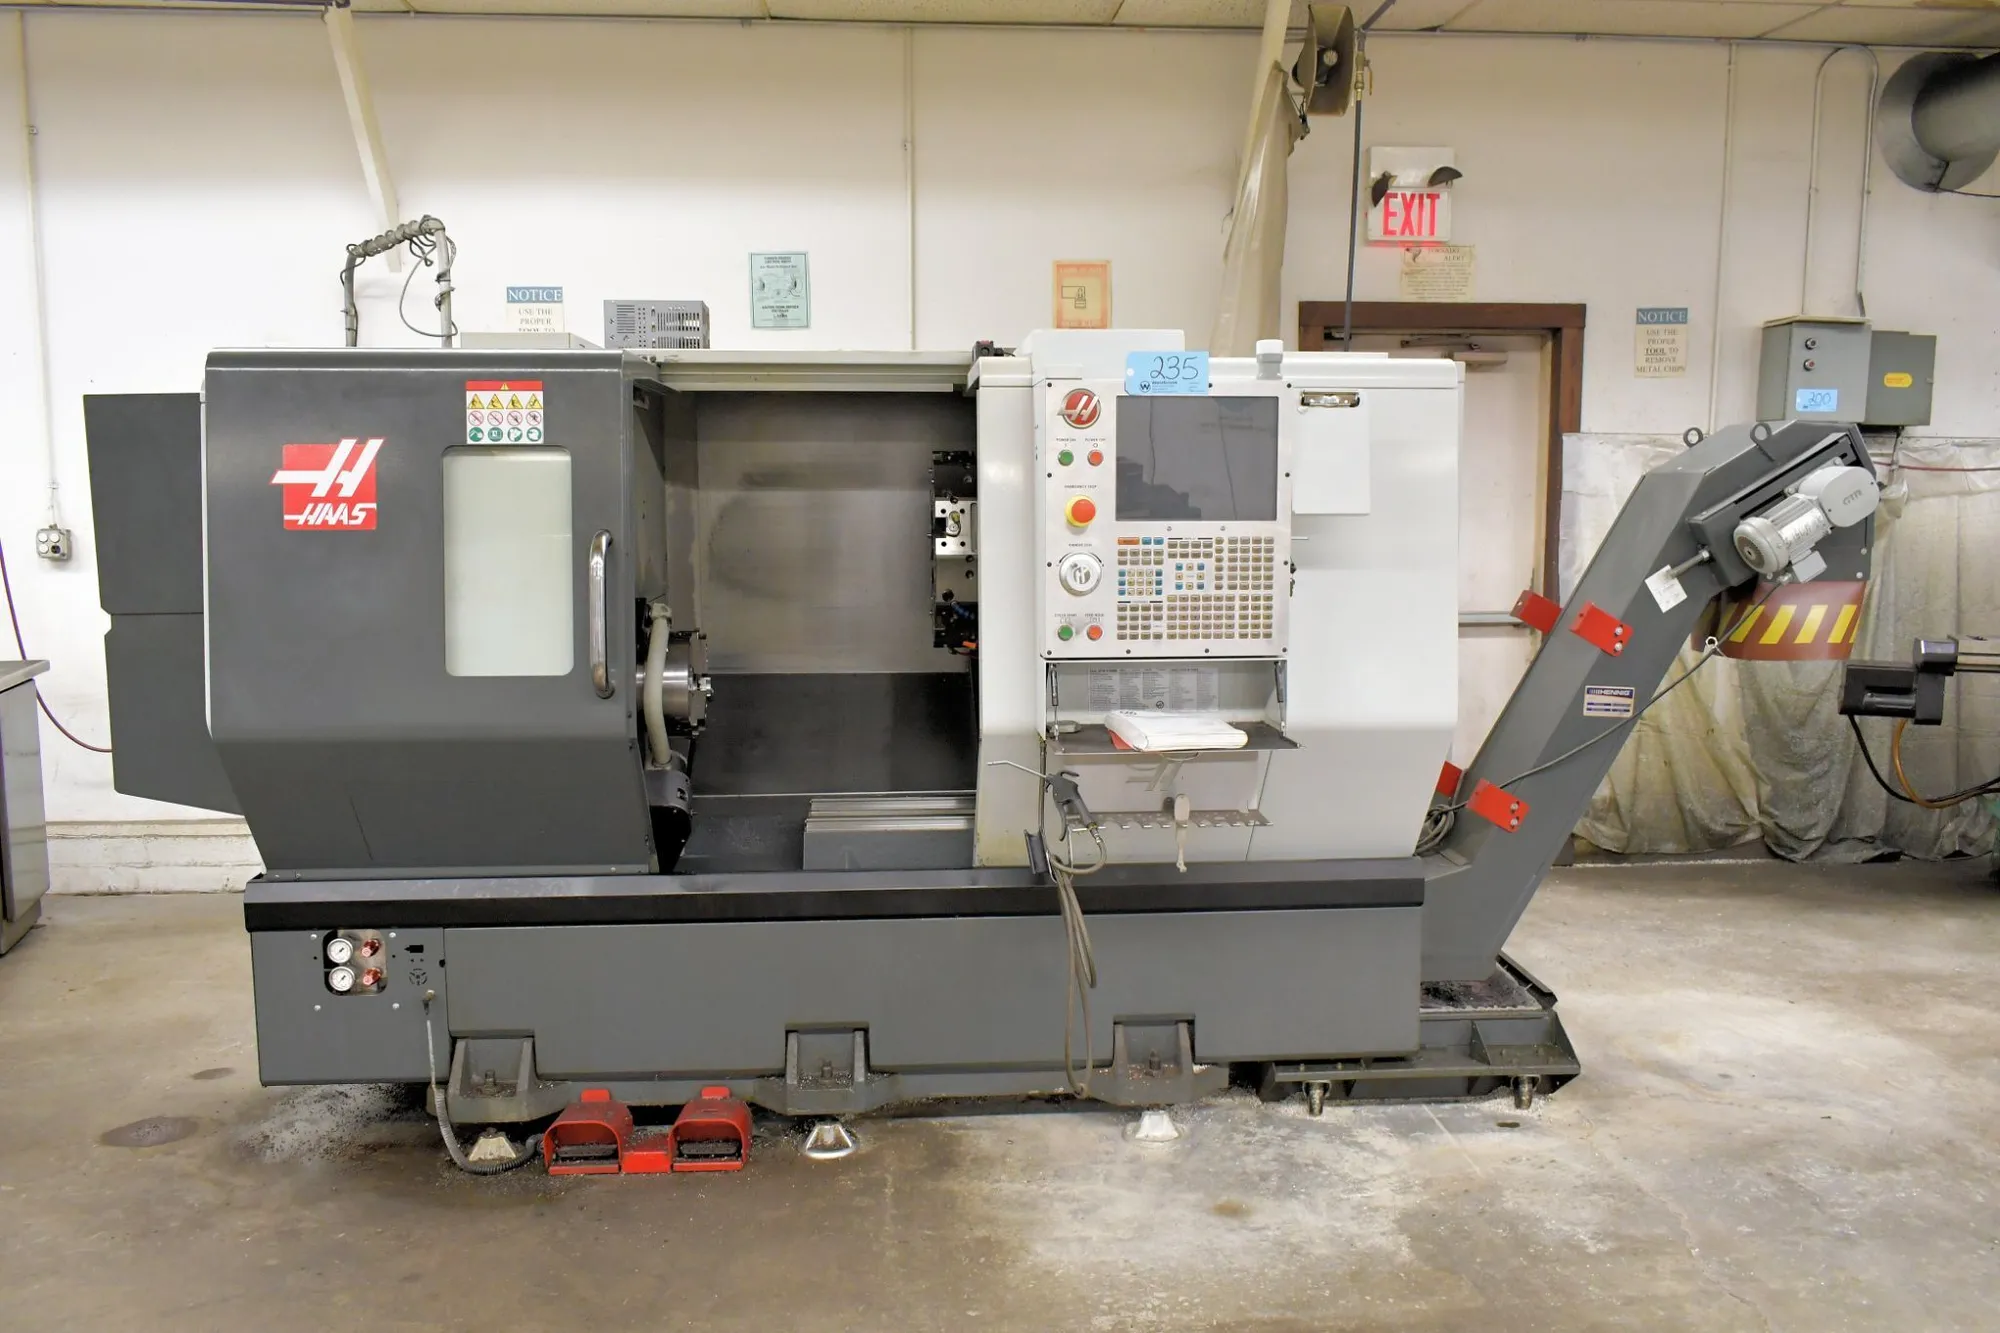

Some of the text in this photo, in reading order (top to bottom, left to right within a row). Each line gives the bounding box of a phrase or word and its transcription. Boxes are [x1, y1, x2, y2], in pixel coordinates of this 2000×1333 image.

[1382, 192, 1440, 237] EXIT
[508, 289, 562, 301] NOTICE
[1638, 310, 1686, 323] NOTICE
[1645, 347, 1666, 355] TOOL
[1150, 355, 1199, 380] 235
[284, 503, 377, 525] HAAS
